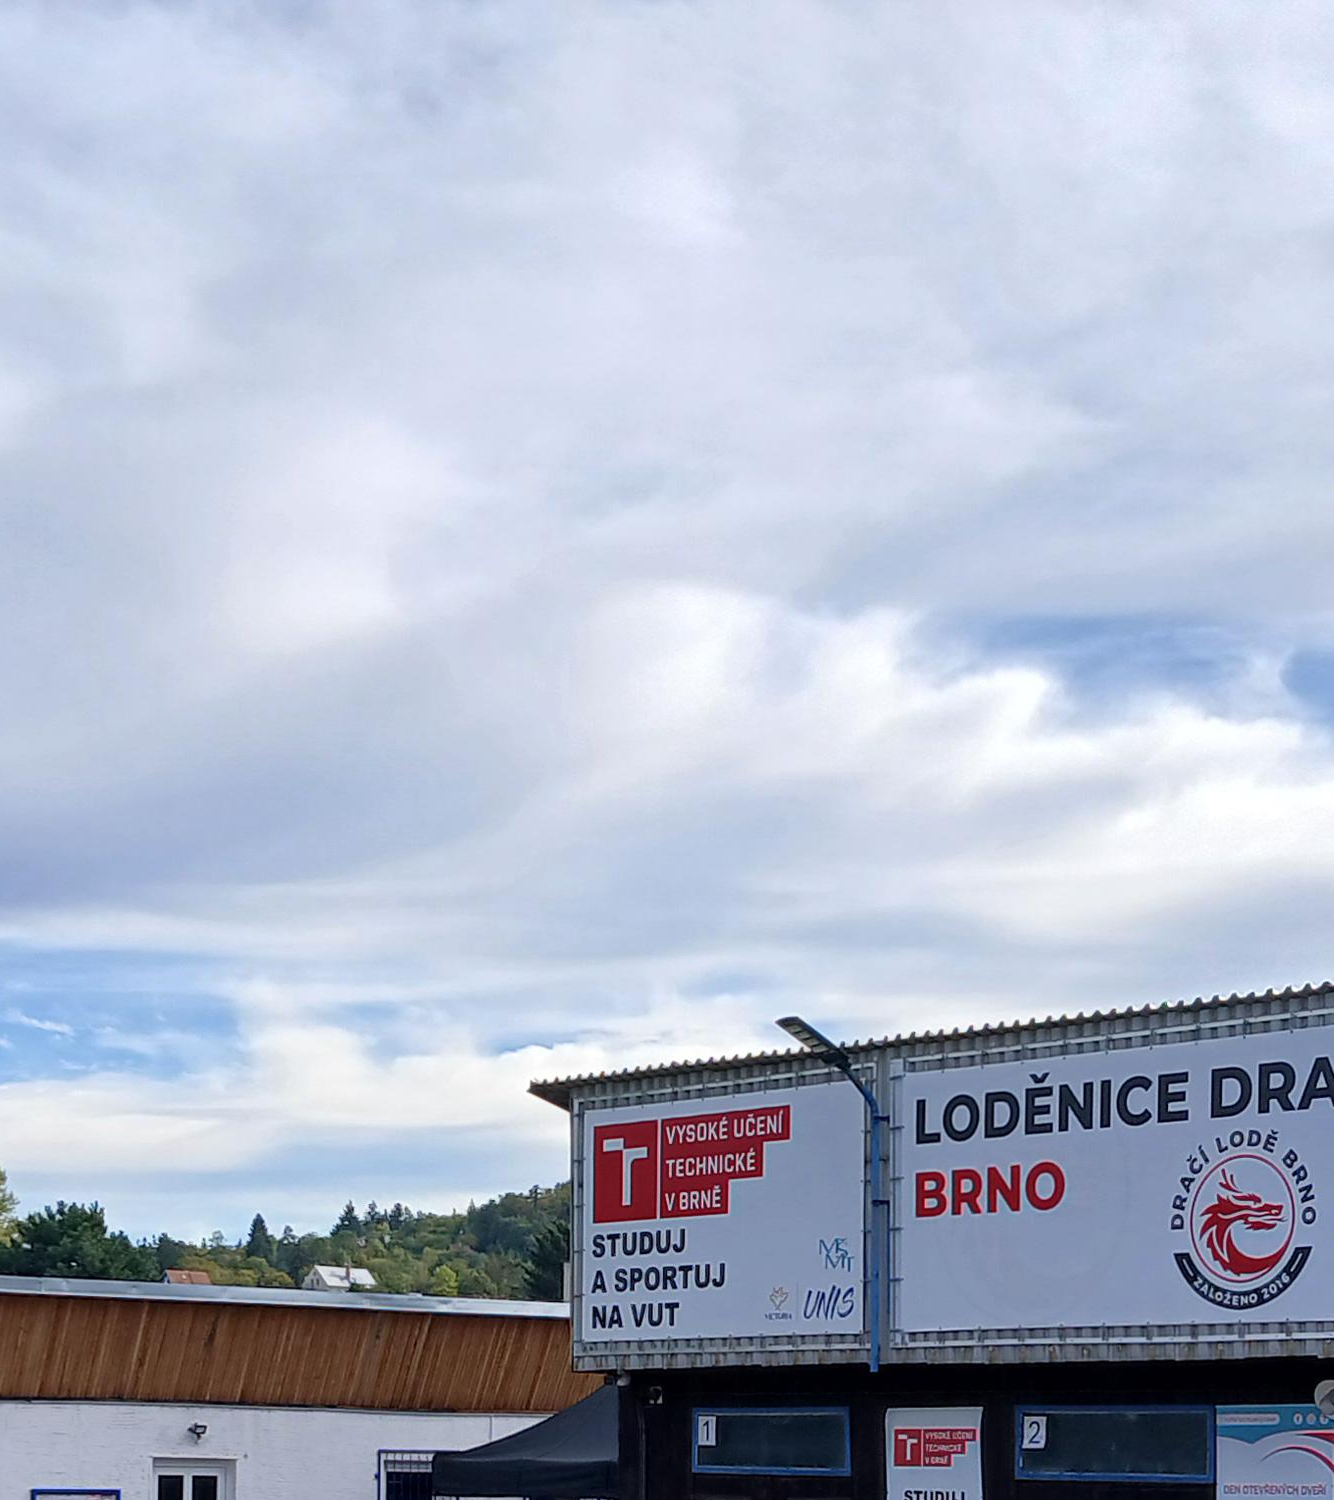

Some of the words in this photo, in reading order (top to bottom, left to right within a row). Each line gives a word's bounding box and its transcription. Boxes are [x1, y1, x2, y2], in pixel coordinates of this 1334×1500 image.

[914, 1072, 1190, 1147] LODĚNICE
[665, 1118, 728, 1145] VYSOKÉ
[733, 1110, 784, 1138] UČENÍ
[665, 1148, 756, 1179] TECHNICKÉ
[914, 1160, 1066, 1219] BRNO
[1170, 1144, 1211, 1231] DRAČÍ
[1215, 1129, 1280, 1154] LODĚ
[1282, 1148, 1317, 1226] BRNO
[664, 1193, 676, 1212] V
[679, 1186, 721, 1210] BRNĚ
[591, 1228, 687, 1259] STUDUJ
[591, 1270, 607, 1294] A
[614, 1262, 727, 1293] SPORTUJ
[1192, 1275, 1259, 1307] ZALOŽENO
[1260, 1273, 1291, 1300] 2016
[592, 1304, 624, 1329] NA
[630, 1302, 680, 1328] VUT
[803, 1284, 855, 1320] UNIS
[702, 1420, 709, 1442] 1
[1027, 1420, 1041, 1444] 2
[1223, 1484, 1241, 1495] DEN
[1243, 1483, 1299, 1496] OTEVŘENÝCH
[1301, 1483, 1327, 1496] DVEŘÍ
